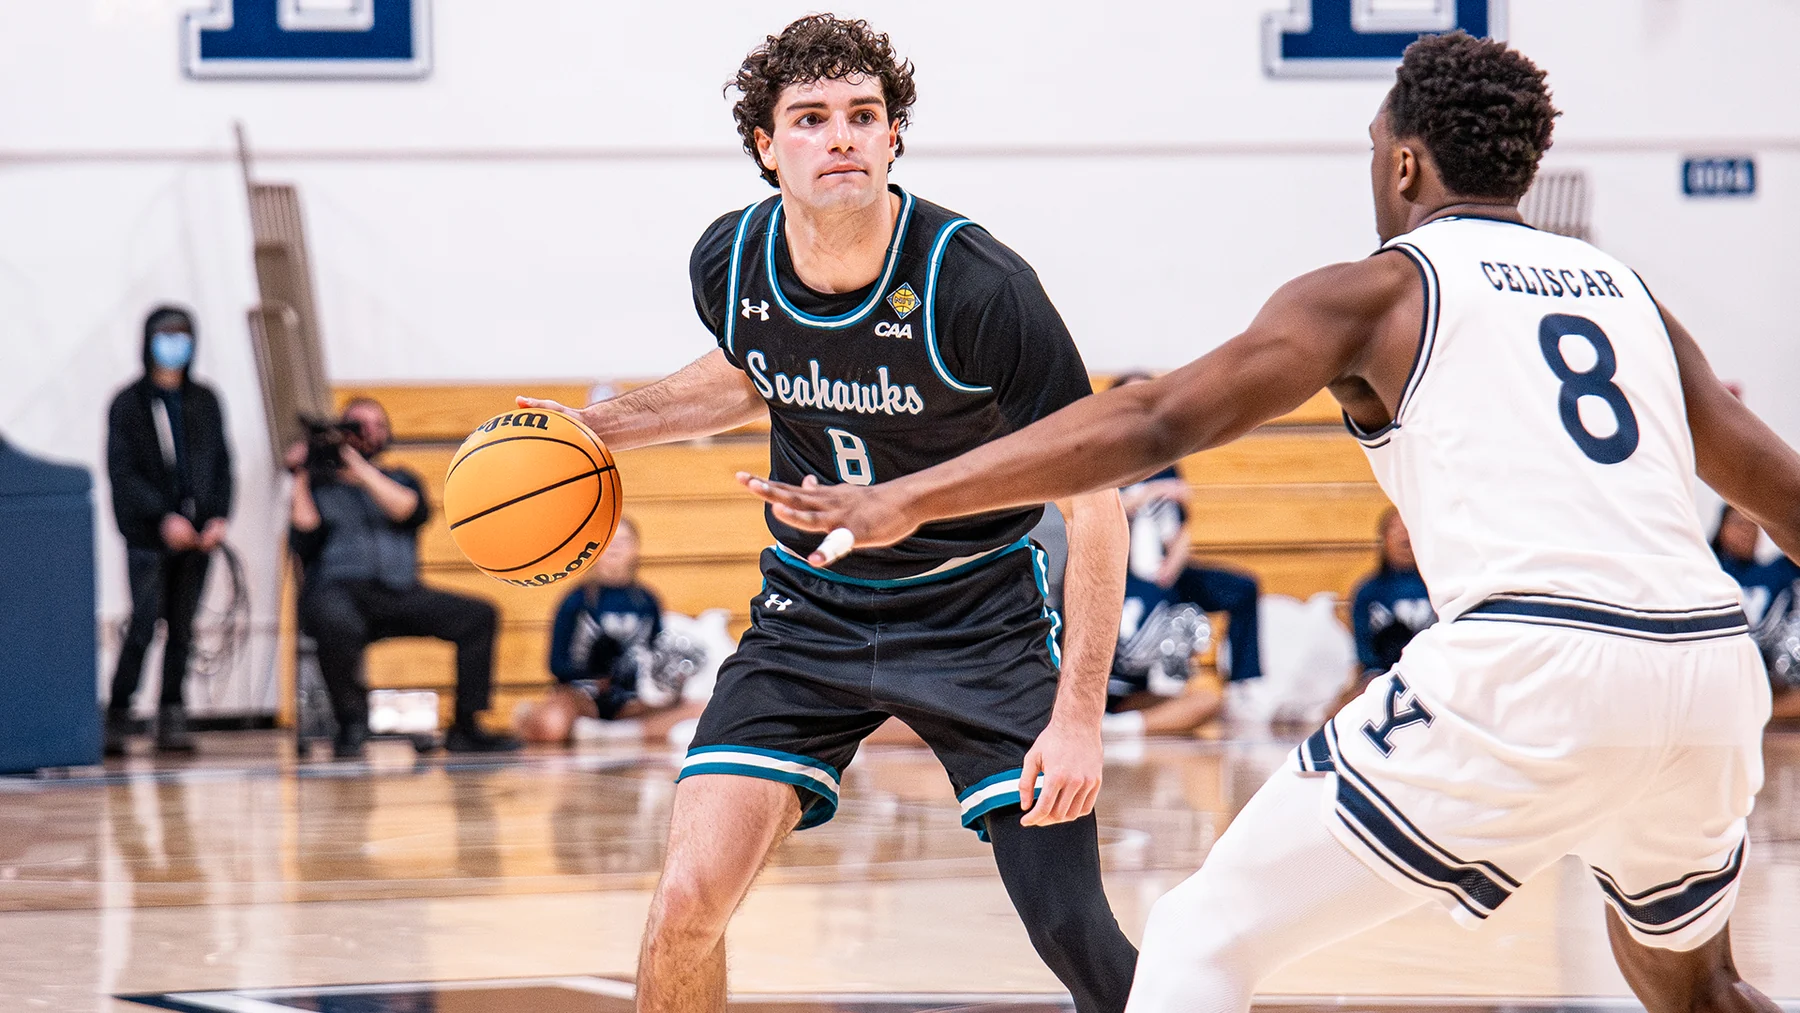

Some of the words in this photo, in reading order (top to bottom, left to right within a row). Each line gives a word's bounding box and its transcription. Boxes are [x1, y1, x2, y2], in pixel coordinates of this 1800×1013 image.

[1480, 261, 1624, 298] CELISCAR
[874, 321, 913, 340] CAA
[746, 350, 925, 416] Seahawks
[1538, 312, 1640, 465] 8
[469, 412, 549, 436] Wil
[824, 426, 876, 486] 8
[1360, 671, 1436, 759] Y
